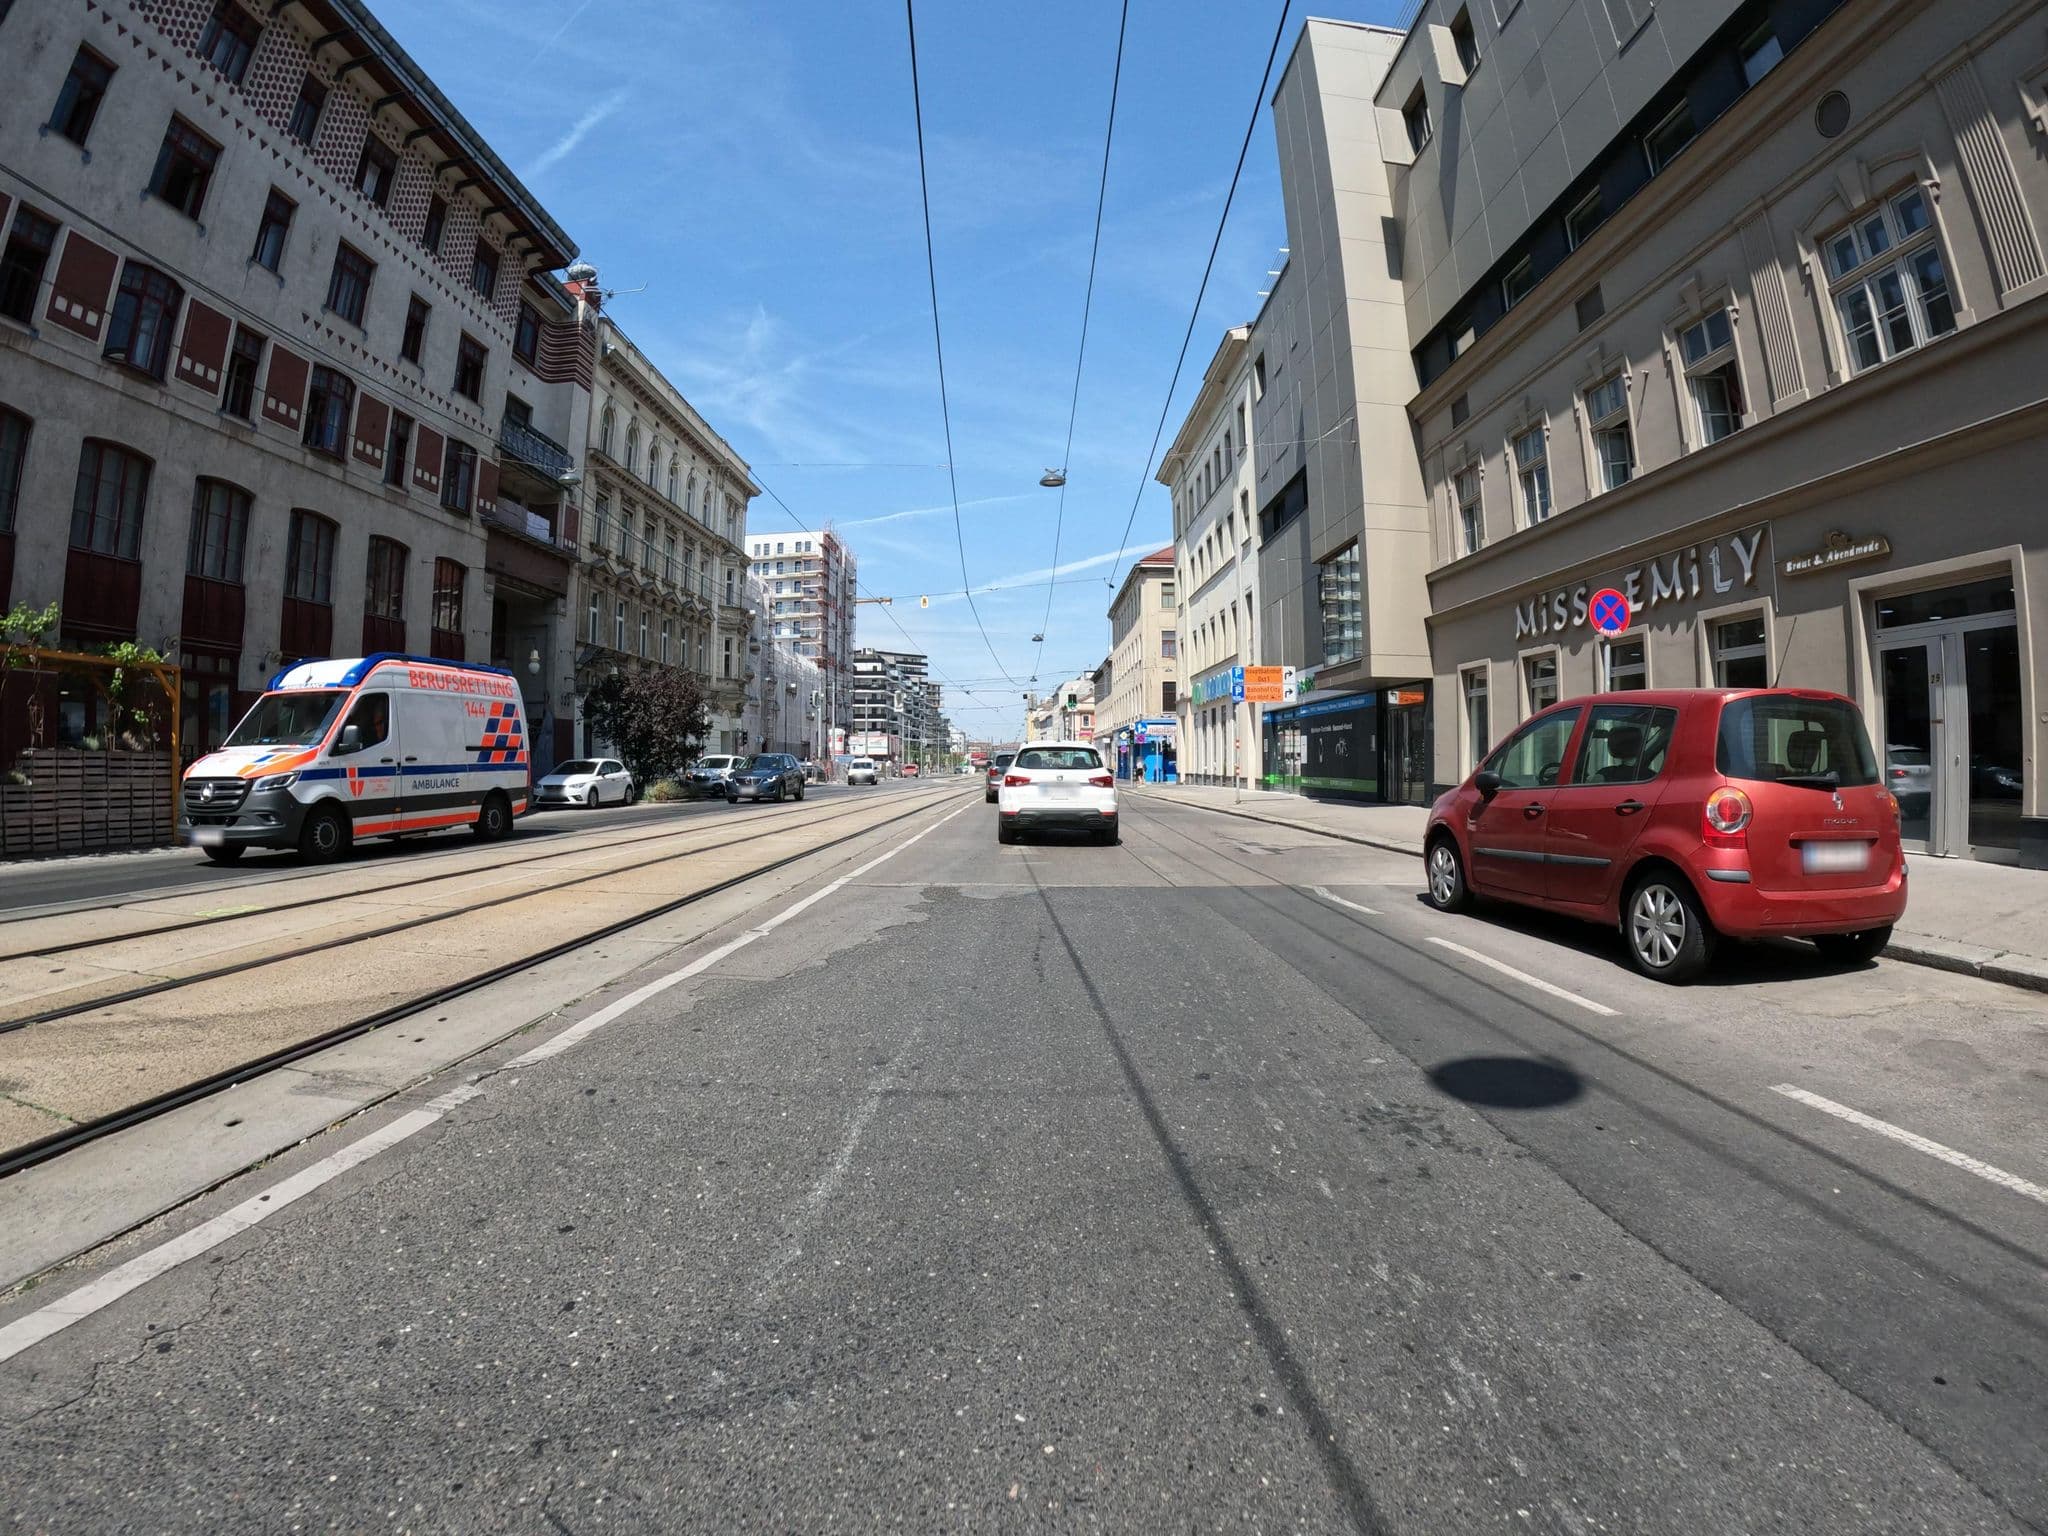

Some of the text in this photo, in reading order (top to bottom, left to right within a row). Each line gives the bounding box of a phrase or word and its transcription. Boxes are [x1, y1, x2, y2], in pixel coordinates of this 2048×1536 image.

[1786, 540, 1880, 572] Braut & Abendmode
[408, 669, 514, 697] BERUFSRETTUNG
[464, 701, 486, 718] 144
[412, 777, 460, 790] AMBULANCE
